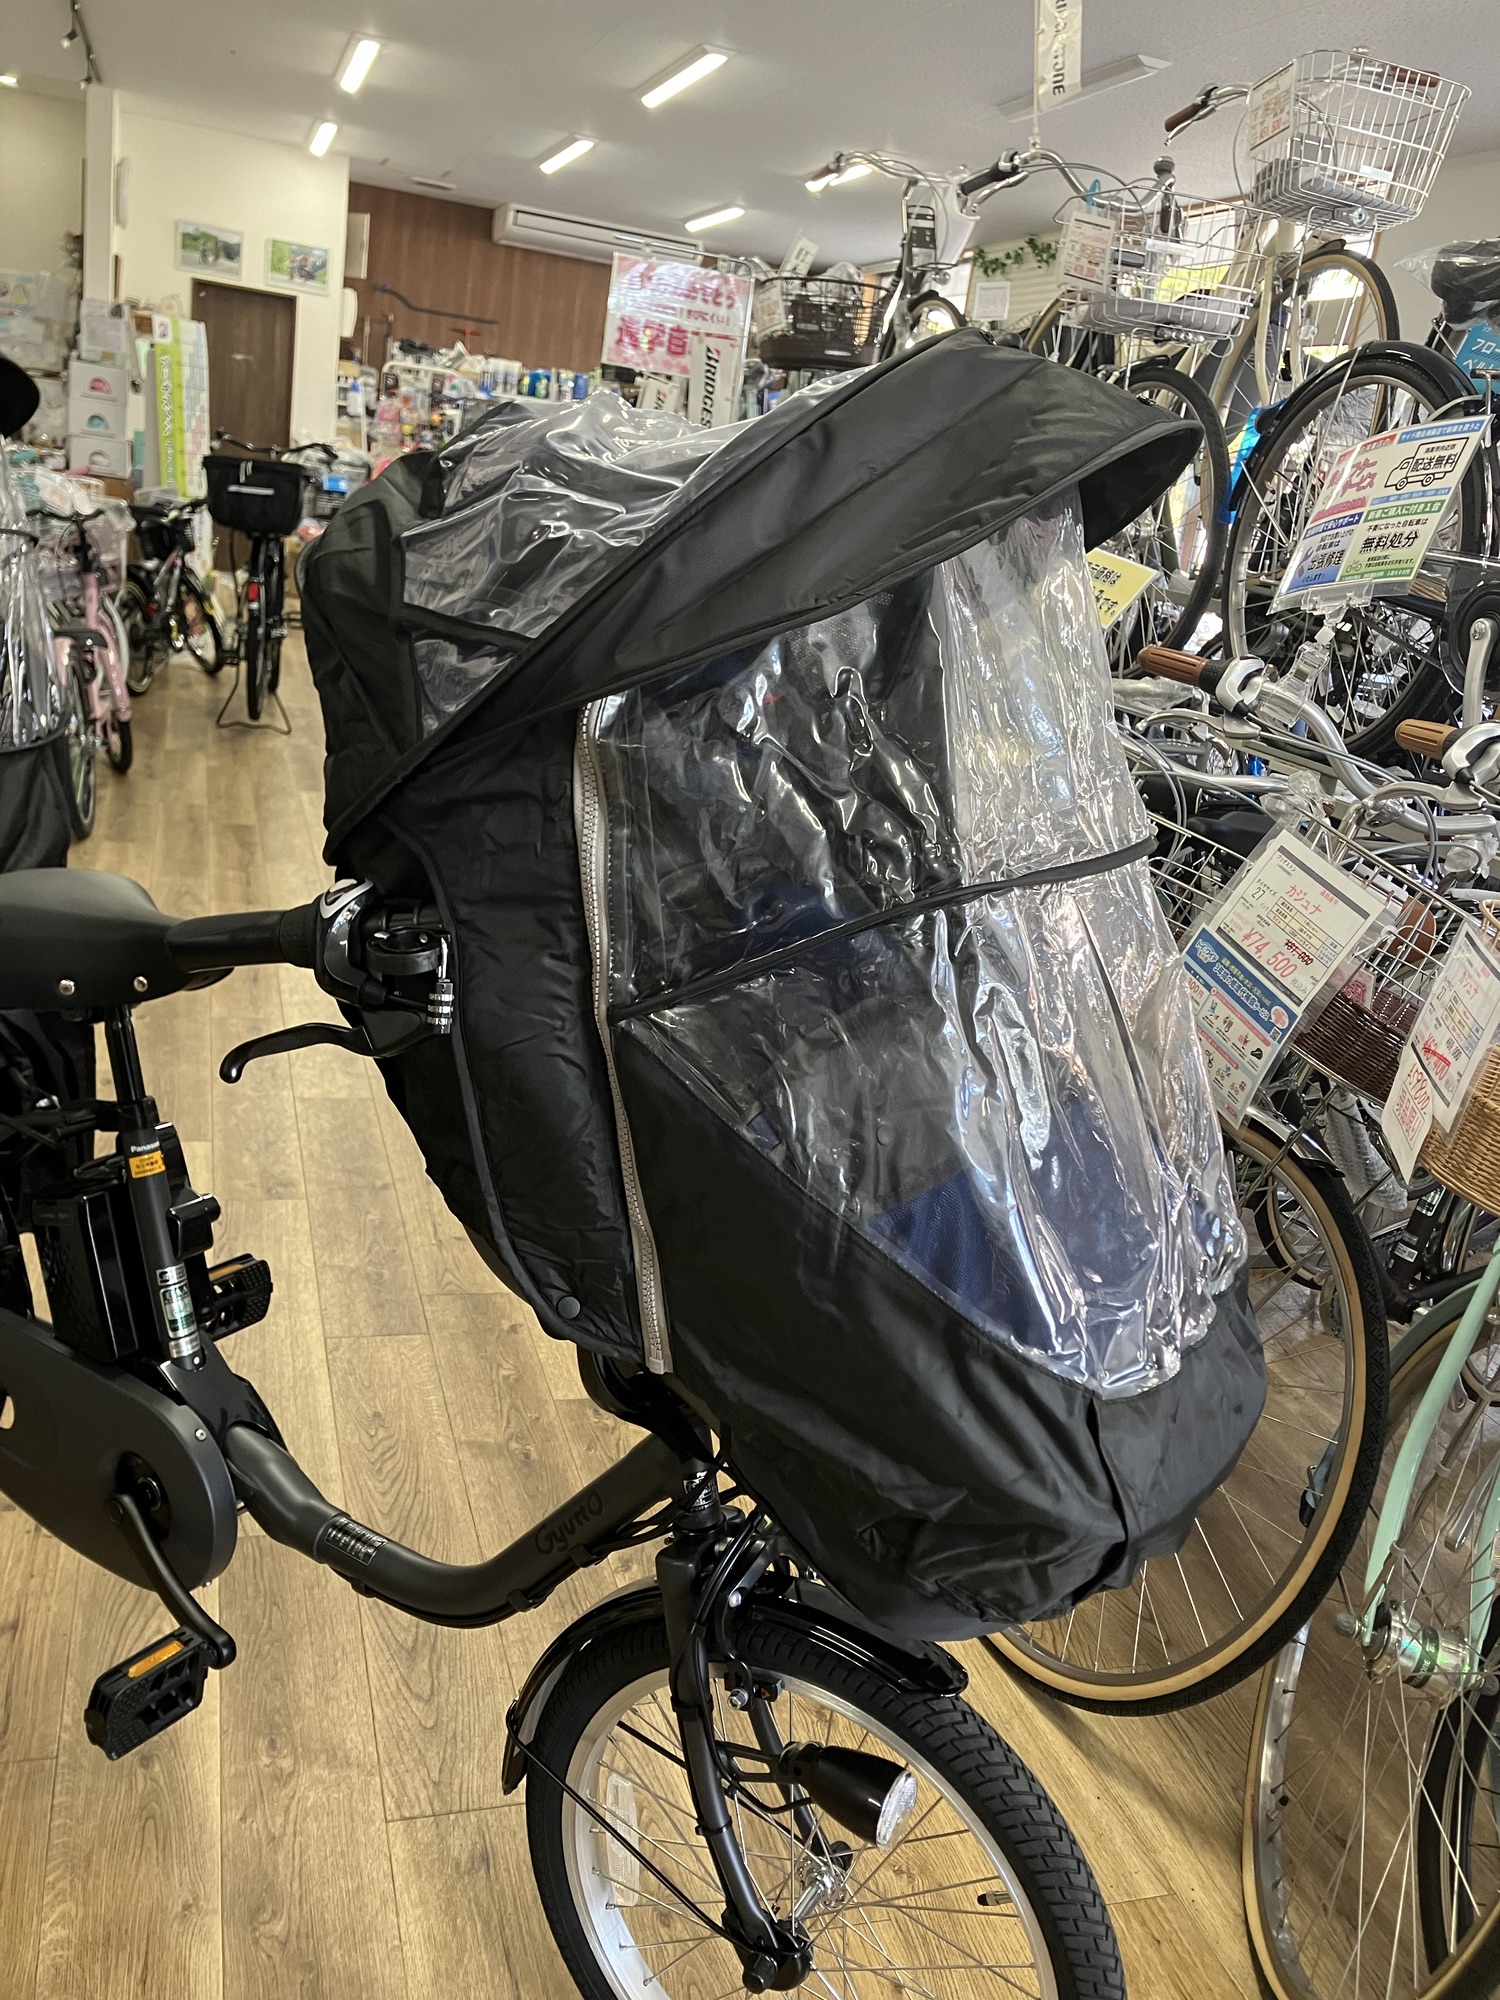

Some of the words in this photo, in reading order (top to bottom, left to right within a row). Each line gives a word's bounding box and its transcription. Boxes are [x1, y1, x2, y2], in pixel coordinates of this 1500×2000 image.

[1410, 452, 1458, 473] 配送無料
[1366, 518, 1428, 532] 不要になった自転車は
[1316, 540, 1341, 552] 自転車は
[1359, 531, 1420, 554] 無料処分
[1307, 550, 1345, 571] 出張修理
[1252, 886, 1266, 901] 27
[1286, 884, 1322, 916] カジュナ
[1241, 927, 1298, 978] ¥74,500
[1459, 969, 1479, 1000] カジュナ
